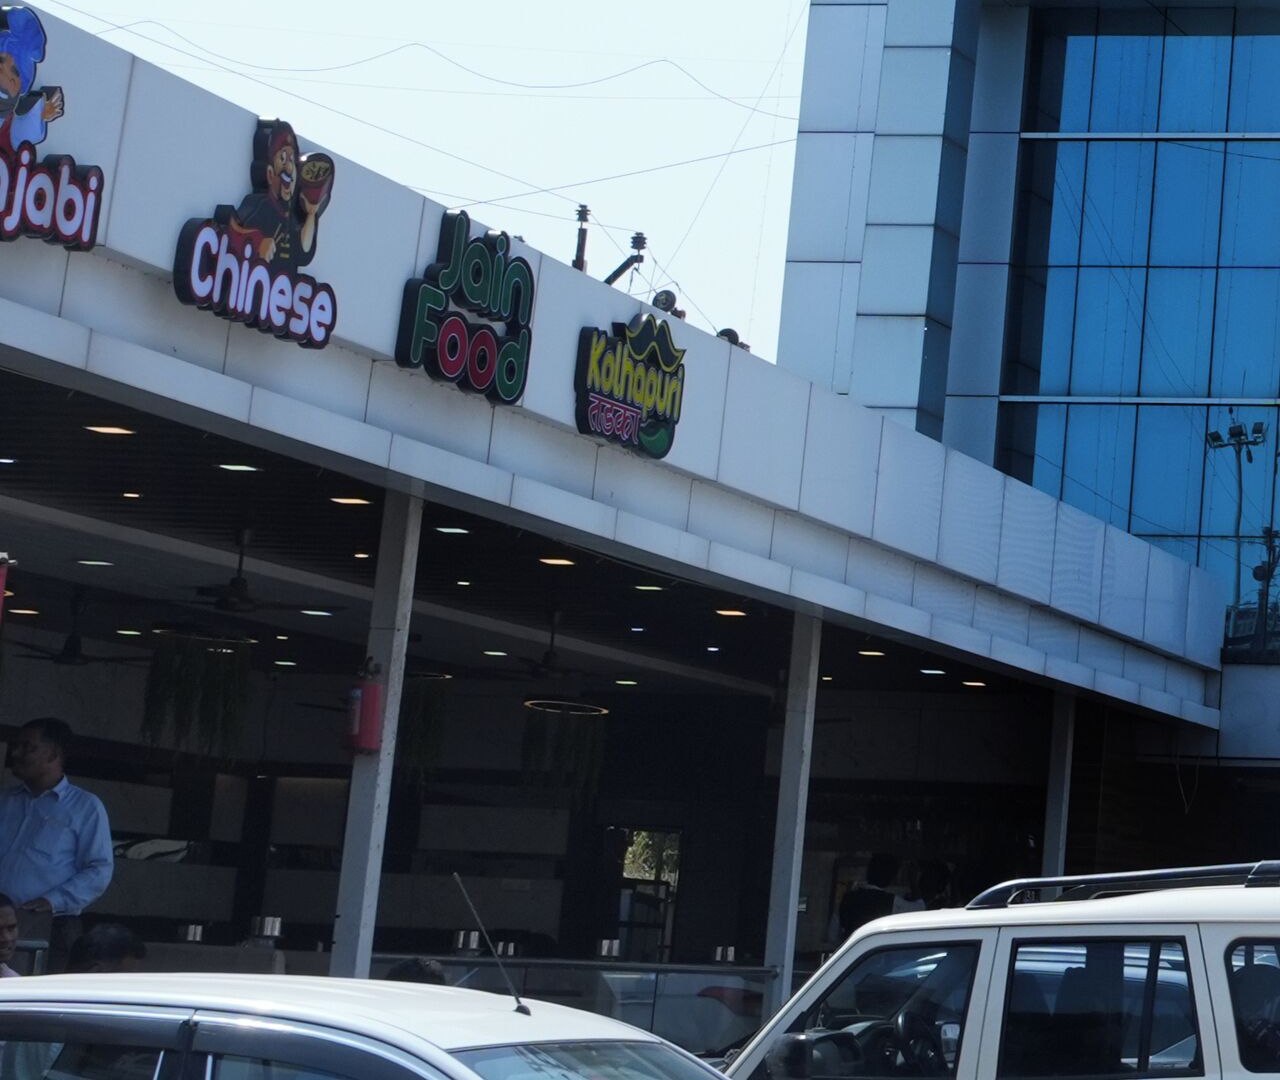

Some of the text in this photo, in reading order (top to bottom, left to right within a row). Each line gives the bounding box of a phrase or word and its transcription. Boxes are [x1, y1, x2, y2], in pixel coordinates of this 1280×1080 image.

[190, 226, 333, 342] Chinese
[438, 214, 532, 325] Jain
[410, 283, 529, 401] Food
[586, 330, 685, 421] Kolhapuri
